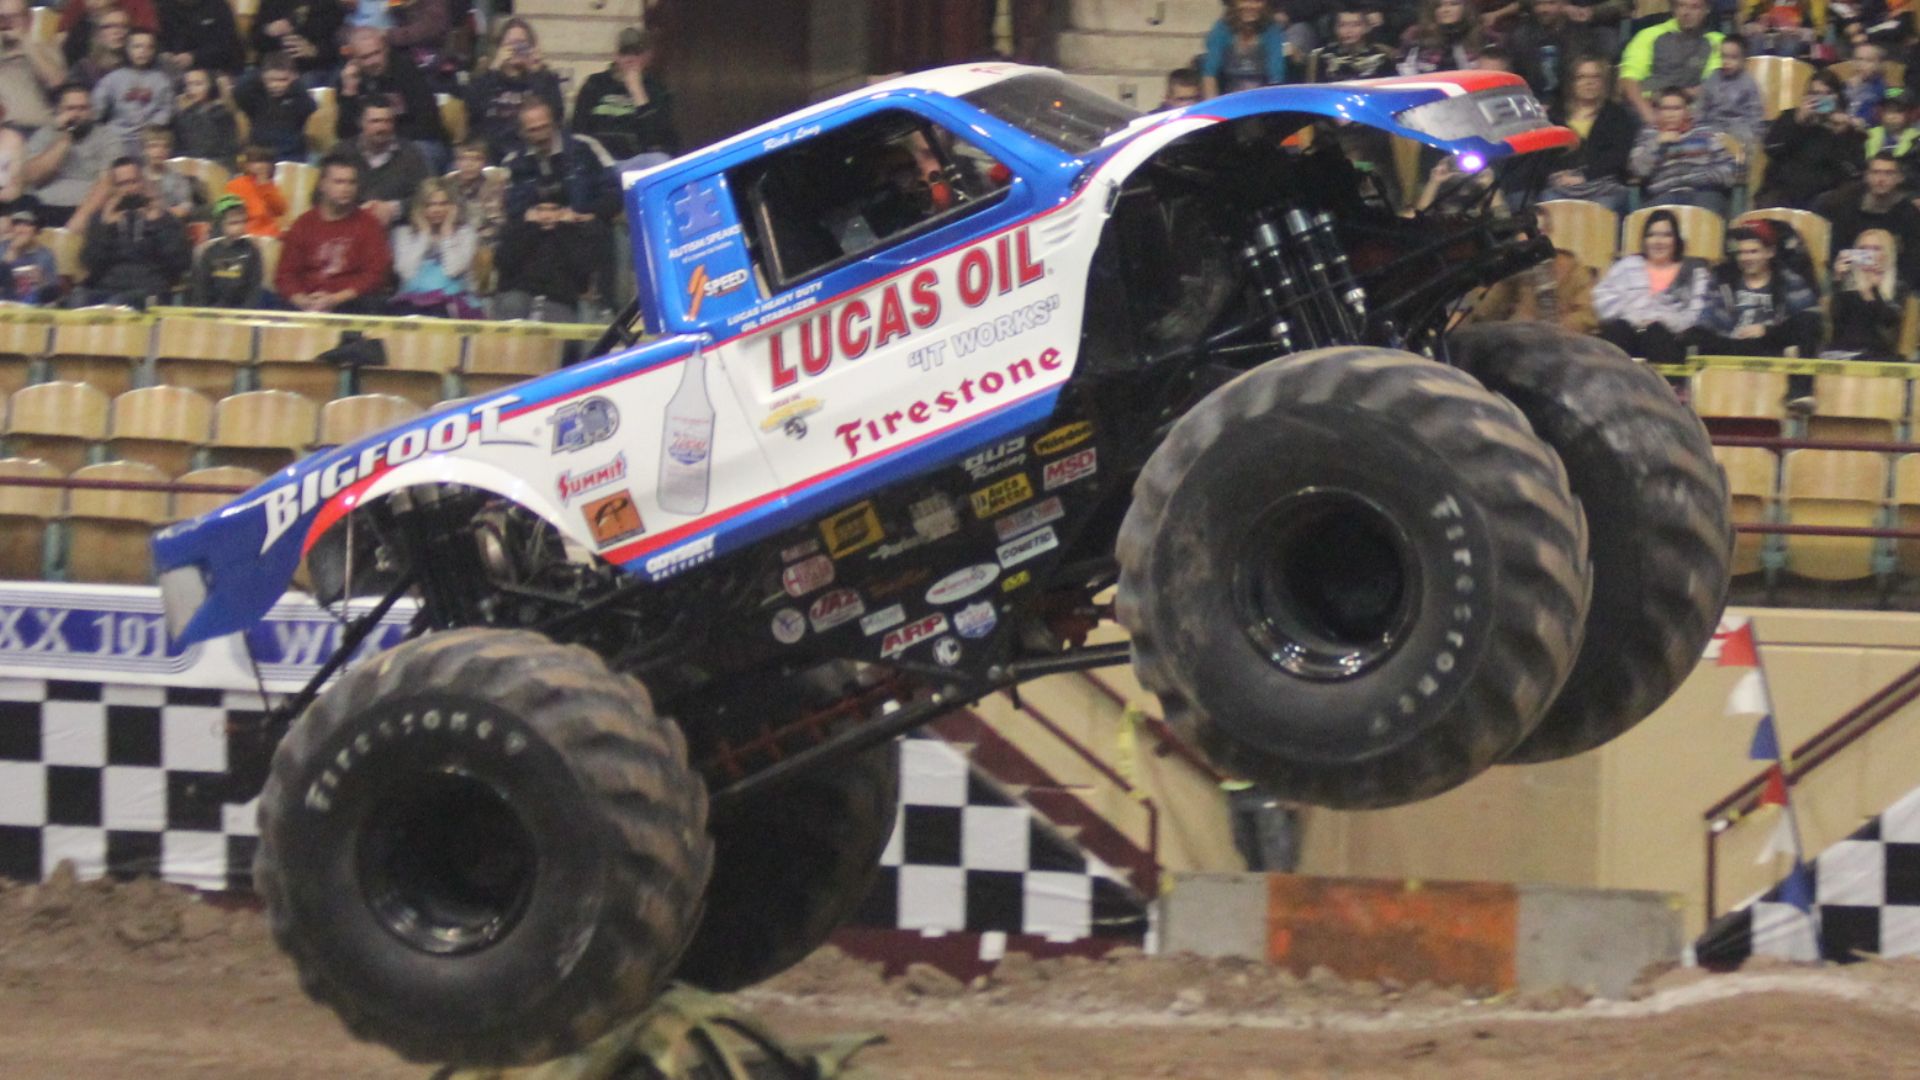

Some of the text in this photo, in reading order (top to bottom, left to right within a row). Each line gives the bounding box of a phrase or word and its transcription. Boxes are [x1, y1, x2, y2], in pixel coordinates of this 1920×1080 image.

[761, 292, 794, 311] HEAVY
[795, 280, 824, 299] DUTY
[769, 225, 1046, 392] LUCAS OIL
[836, 345, 1064, 459] Firestone
[222, 395, 540, 556] BIGFOOT
[1046, 450, 1095, 480] MSD
[93, 612, 168, 659] 101
[883, 612, 944, 652] ARP
